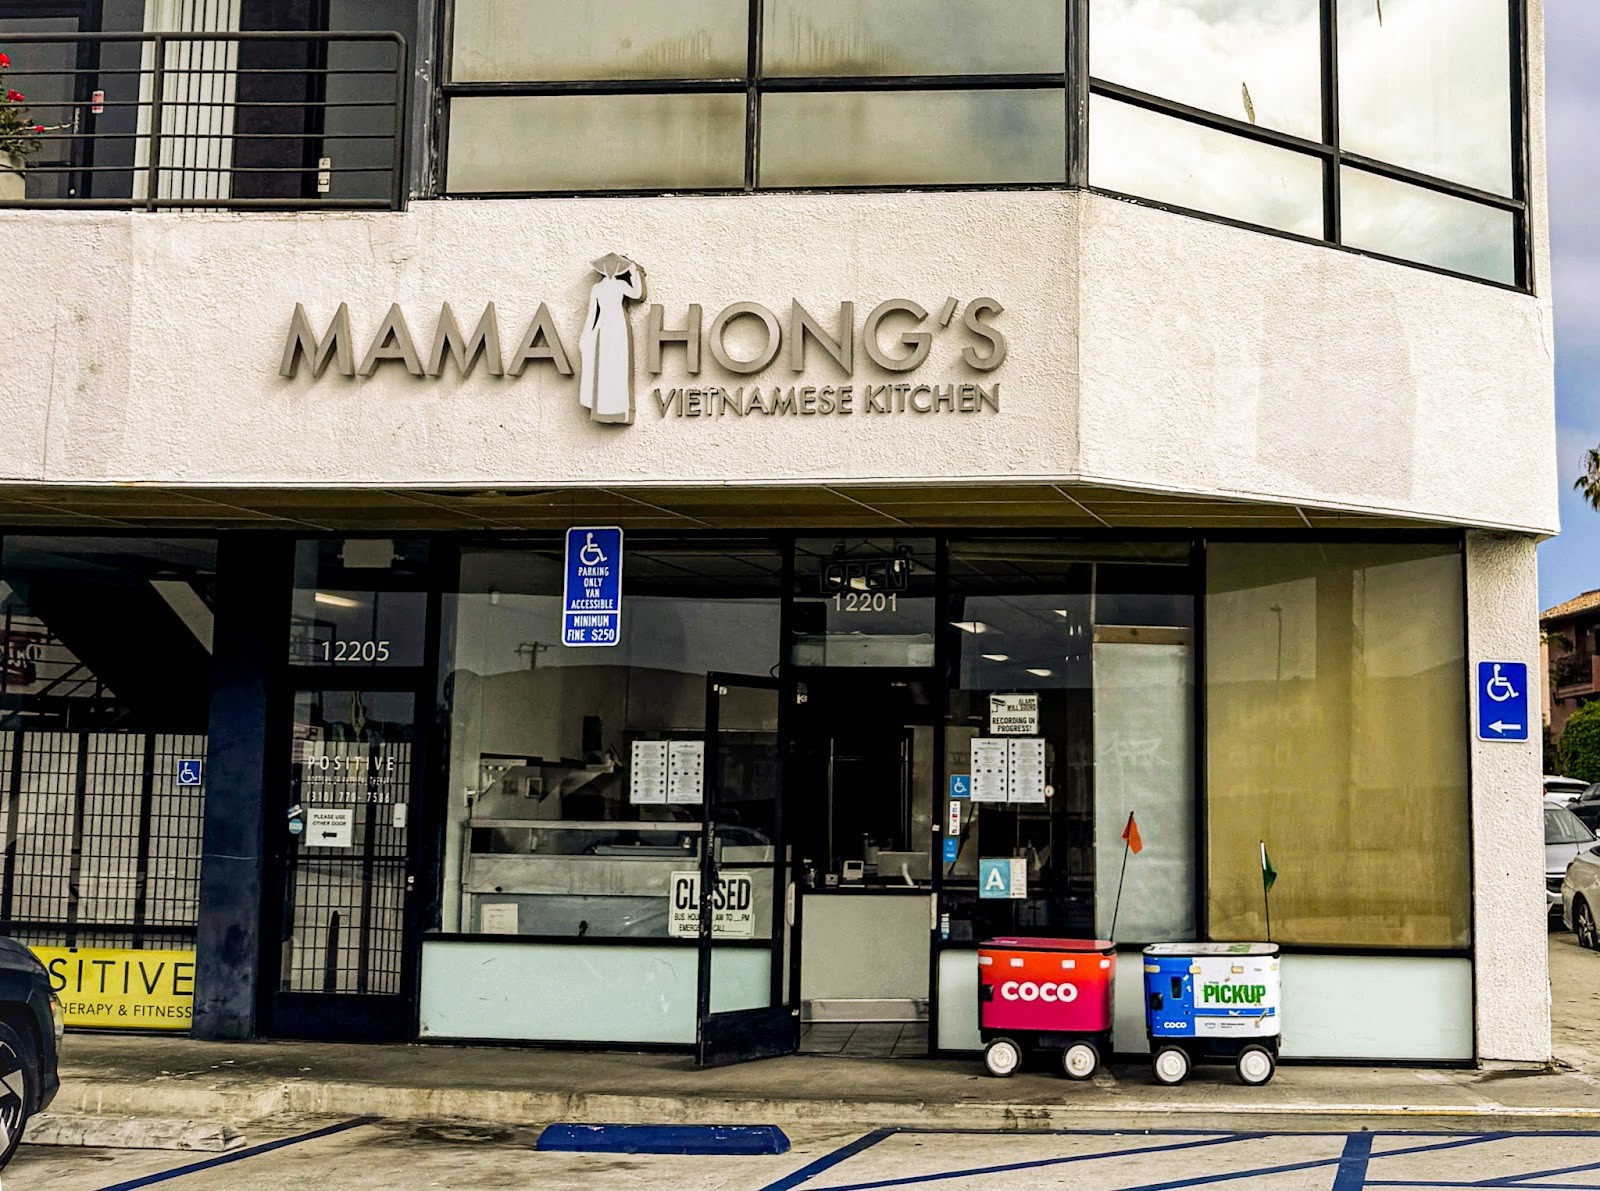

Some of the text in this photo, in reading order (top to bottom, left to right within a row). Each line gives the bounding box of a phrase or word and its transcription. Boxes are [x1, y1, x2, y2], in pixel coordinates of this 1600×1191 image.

[279, 296, 1007, 378] MAMA HONG'S
[653, 383, 1001, 419] VIETNAMESE KITCHEN
[578, 567, 609, 577] PARKING
[825, 563, 903, 588] OPEN
[583, 577, 603, 588] ONLY
[585, 588, 600, 598] VAN
[571, 599, 614, 609] ACCESSIBLE
[832, 592, 897, 612] 12201
[573, 615, 609, 627] MINIMUM
[567, 629, 586, 641] FINE
[321, 641, 390, 662] 12205
[307, 755, 395, 771] POSITIVE
[985, 867, 1006, 890] A
[676, 878, 751, 910] CLSED
[715, 913, 724, 921] AM
[725, 913, 734, 922] TO
[713, 924, 725, 932] CALL
[48, 957, 195, 996] SITIVE
[1203, 984, 1267, 1004] PICKUP
[62, 1002, 193, 1019] HERAPY & FITNESS
